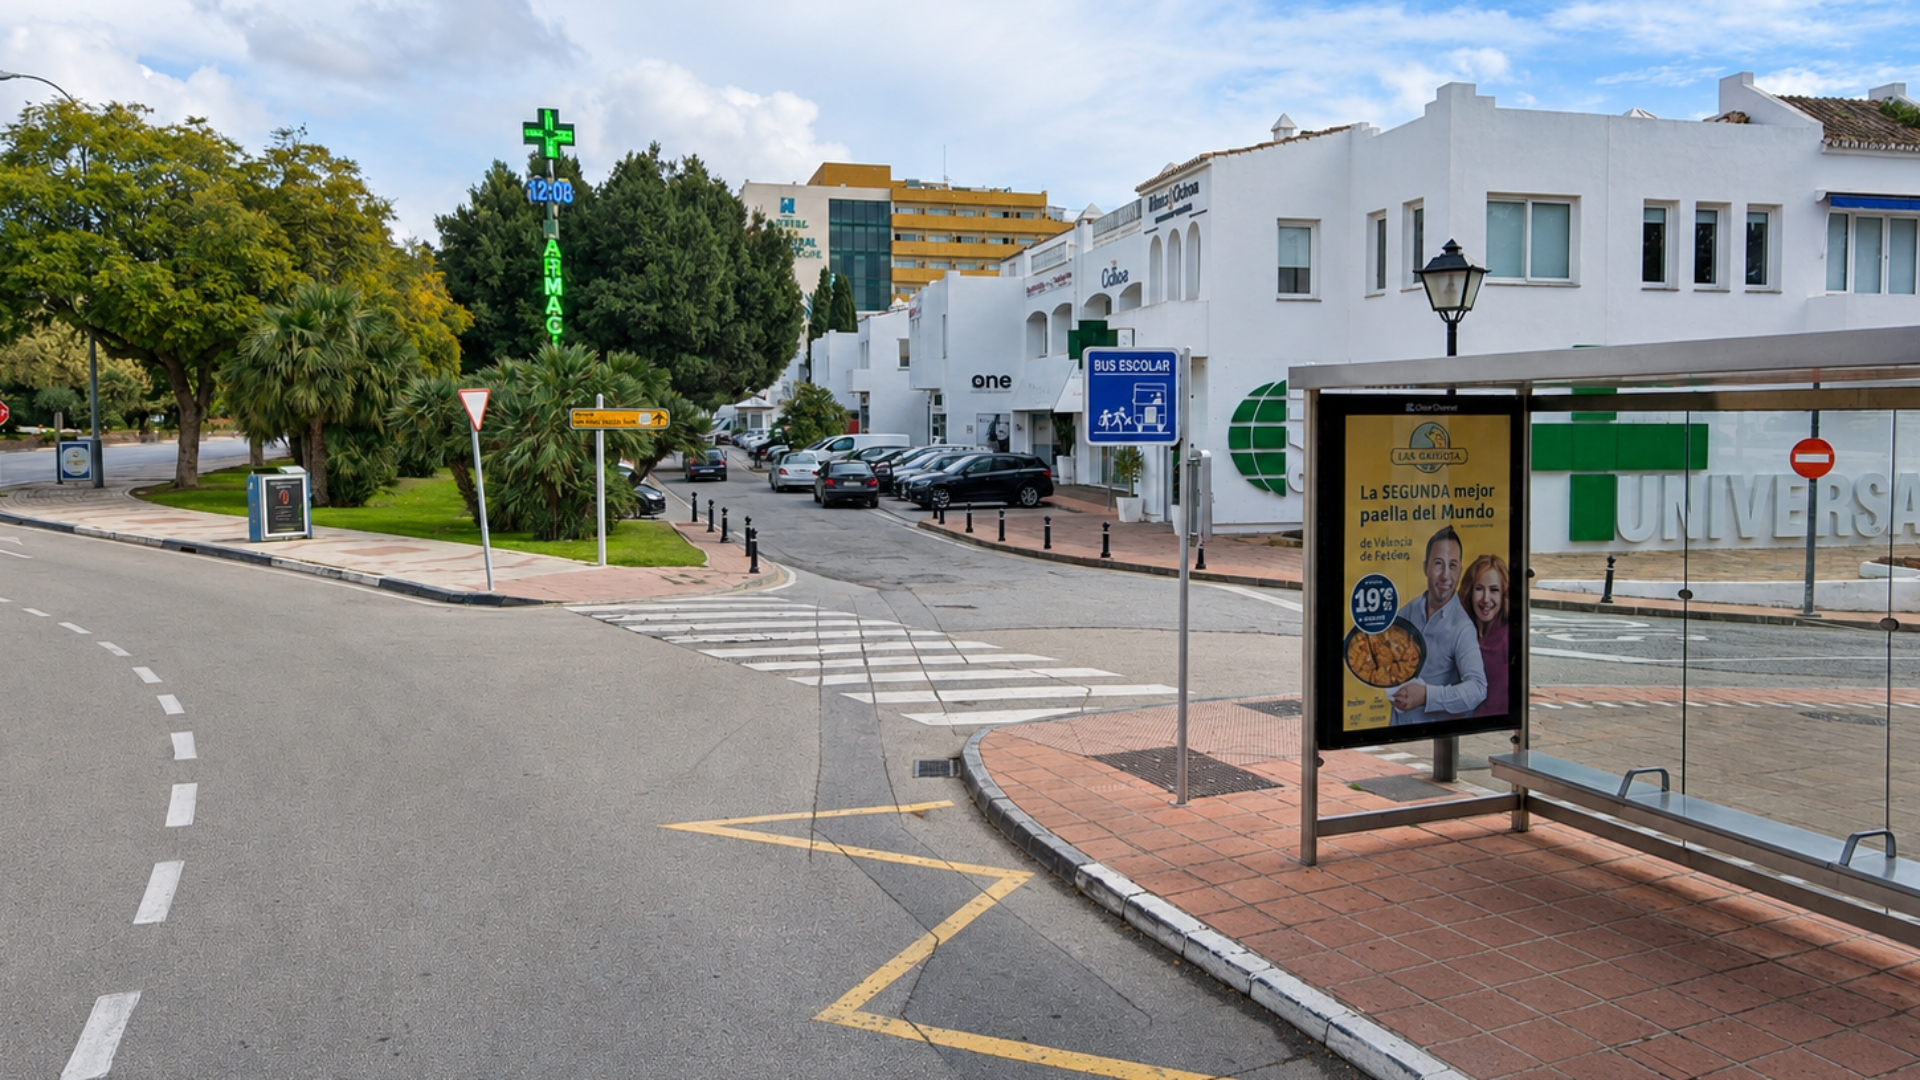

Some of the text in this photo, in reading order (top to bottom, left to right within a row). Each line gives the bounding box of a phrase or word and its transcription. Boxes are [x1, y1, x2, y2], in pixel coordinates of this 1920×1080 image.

[528, 179, 574, 204] 12:08
[1094, 359, 1170, 372] BUS ESCOLAR
[971, 374, 1012, 389] one
[1360, 483, 1495, 500] La SEGUNDA mejor
[1360, 502, 1494, 527] paella del Mundo
[1360, 537, 1372, 548] de
[1360, 551, 1372, 562] de
